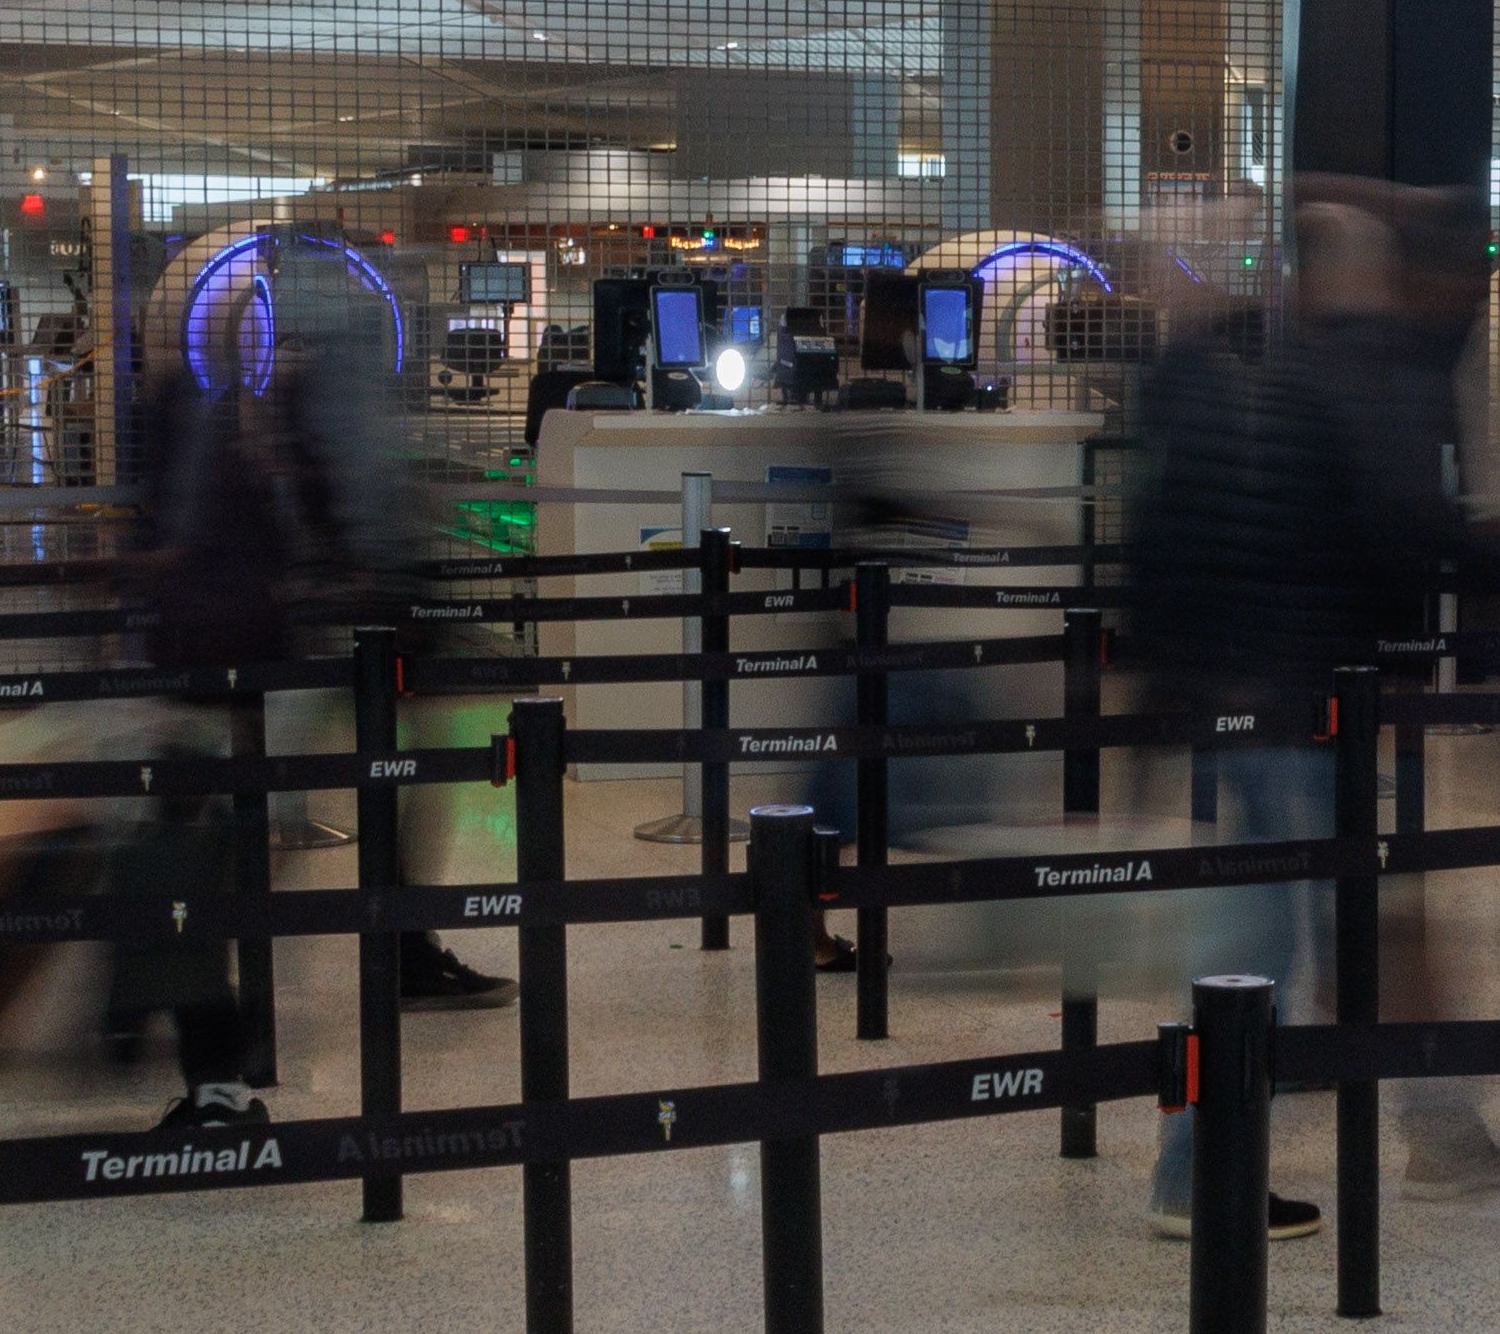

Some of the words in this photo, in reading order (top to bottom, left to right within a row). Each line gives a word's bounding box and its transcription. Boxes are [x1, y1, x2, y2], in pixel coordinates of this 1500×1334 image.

[1216, 715, 1254, 731] EWR
[1035, 862, 1133, 886] Terminal
[1135, 861, 1154, 881] A
[464, 895, 522, 916] EWR
[972, 1069, 1043, 1100] EWR
[82, 1141, 250, 1180] Terminal
[254, 1139, 284, 1169] A
